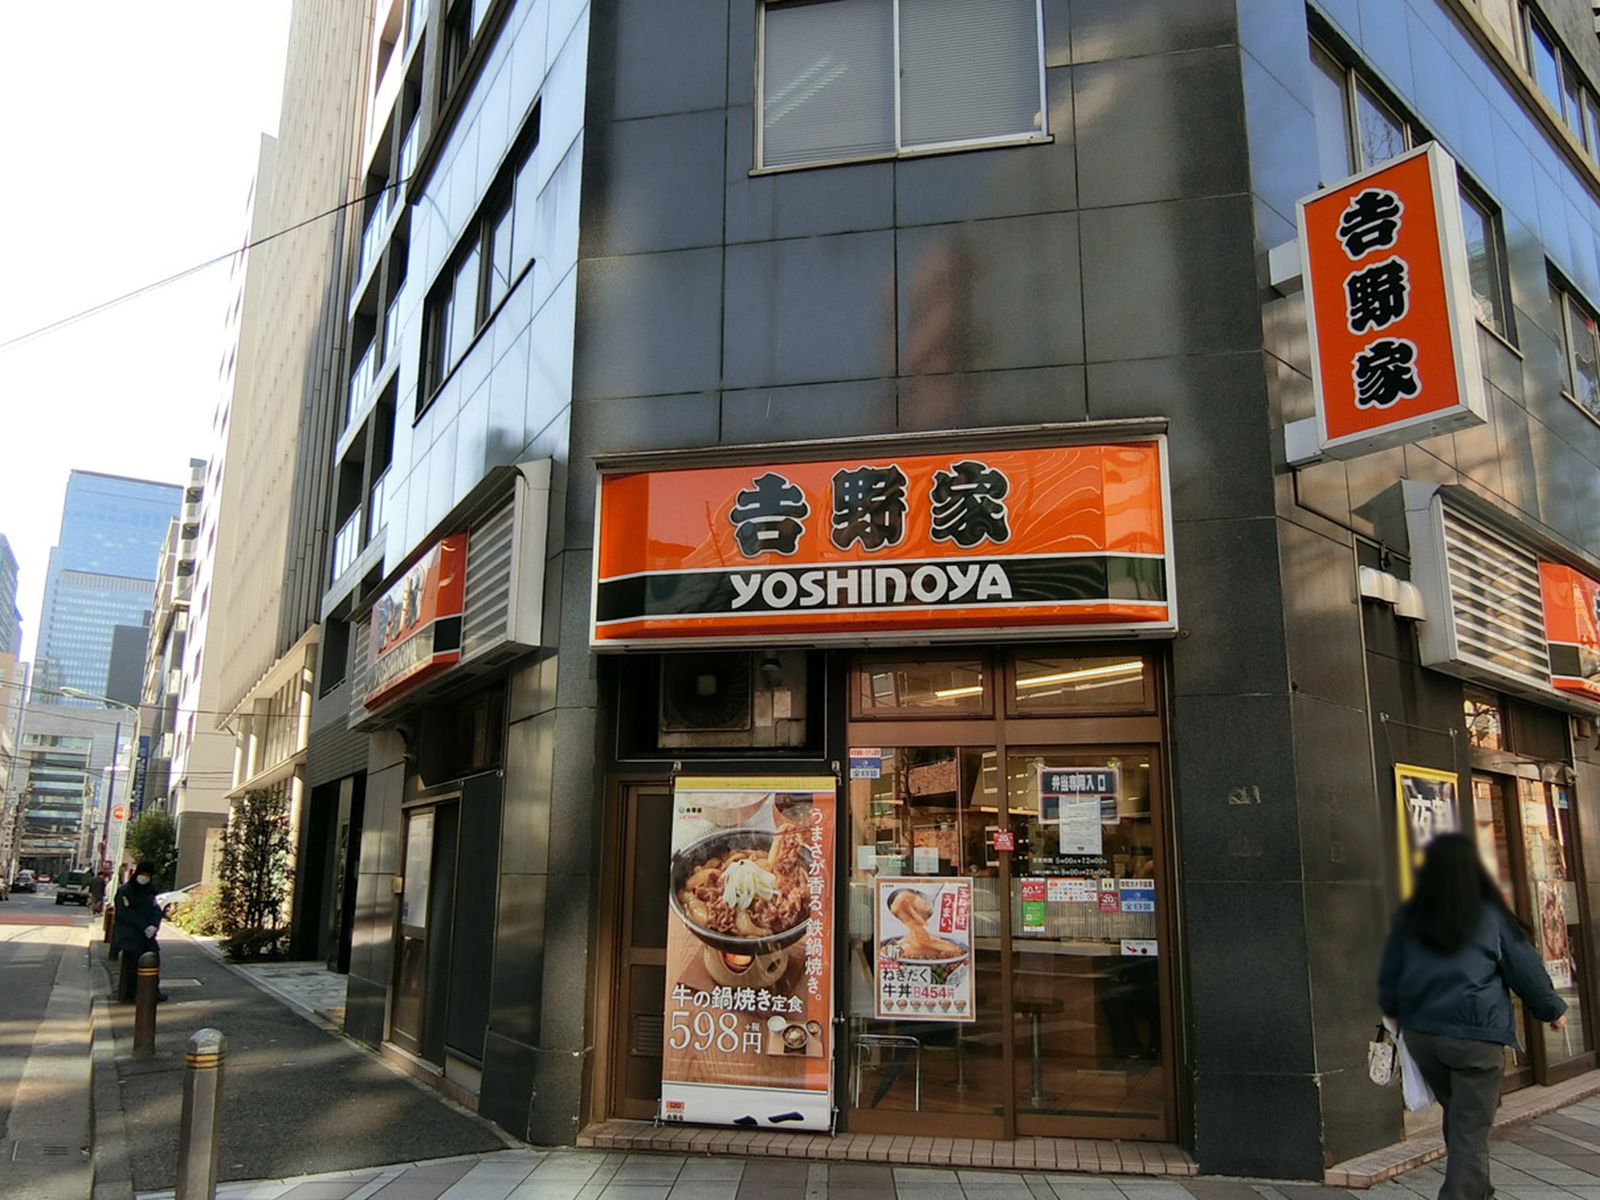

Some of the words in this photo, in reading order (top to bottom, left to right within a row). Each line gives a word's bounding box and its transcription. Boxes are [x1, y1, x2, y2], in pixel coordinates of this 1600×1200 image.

[728, 562, 1013, 610] YOSHINOYA
[883, 967, 928, 983] ねぎだく
[671, 984, 804, 1013] 牛の鍋焼き定食
[883, 983, 912, 998] 牛丼
